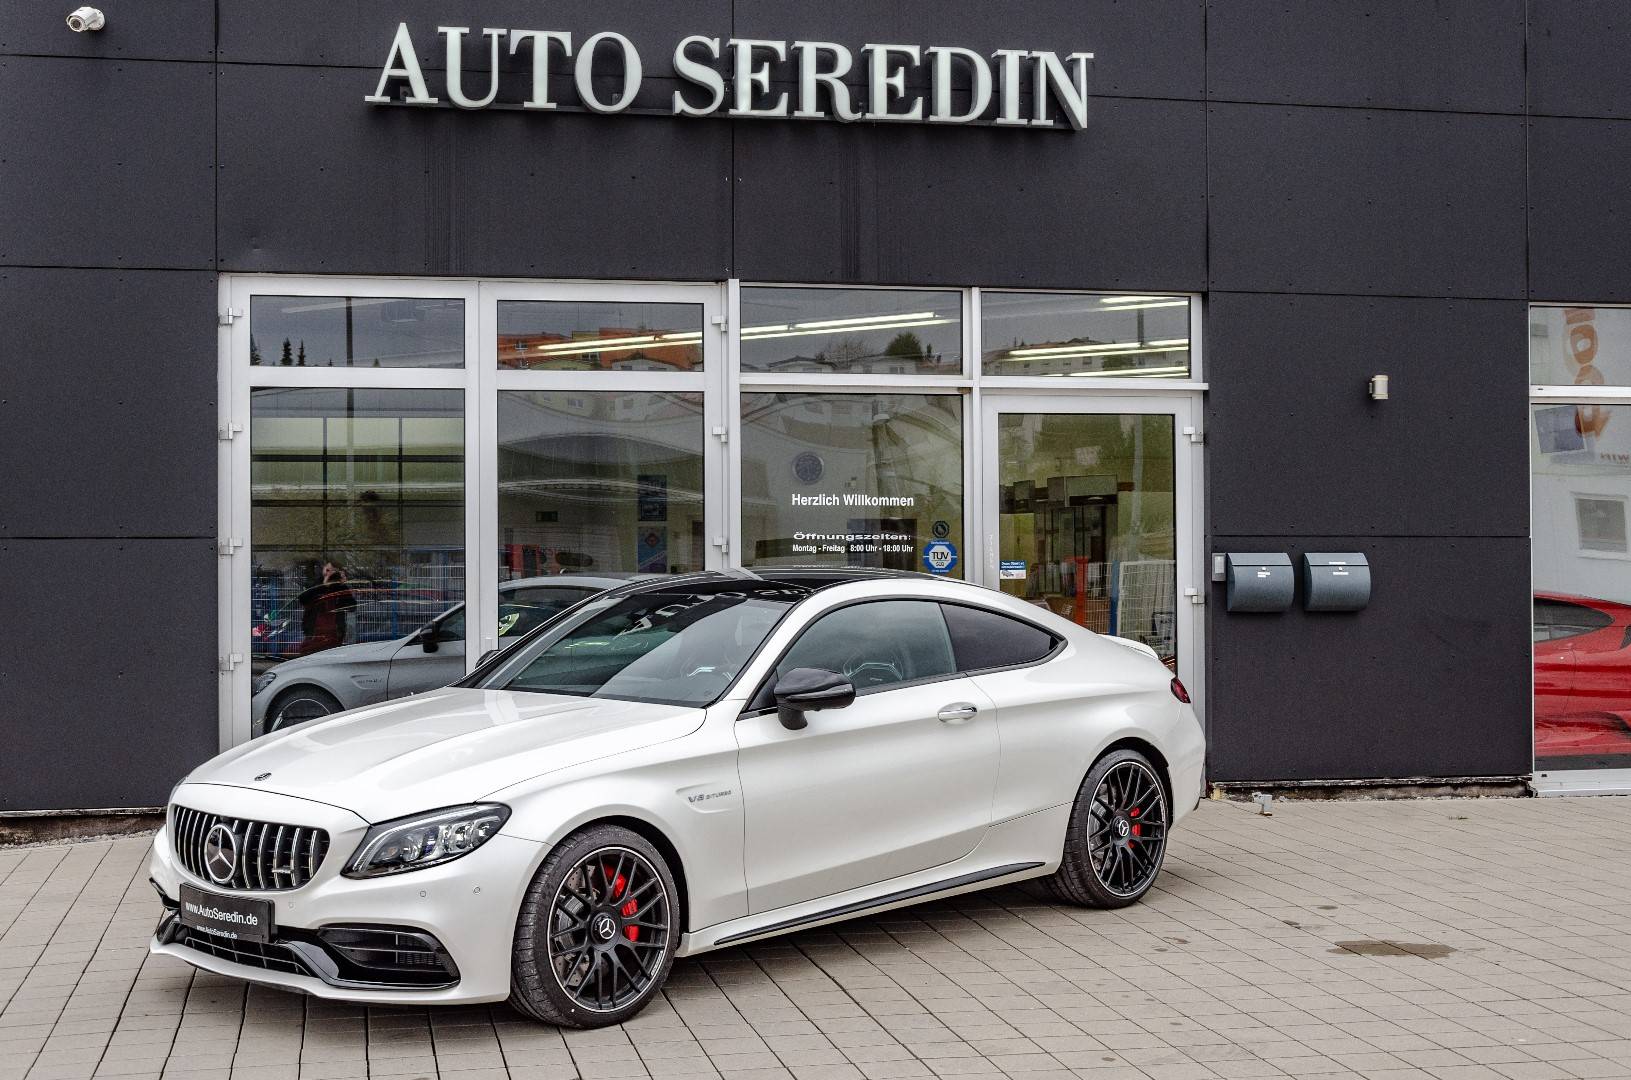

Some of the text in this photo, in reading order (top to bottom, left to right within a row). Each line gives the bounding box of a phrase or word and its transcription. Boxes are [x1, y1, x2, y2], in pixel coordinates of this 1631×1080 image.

[364, 22, 1095, 130] AUTO SEREDIN
[791, 493, 914, 507] Herzlich Willkommen
[793, 531, 911, 541] Öffnungszeiten:
[792, 544, 817, 554] Montag
[822, 544, 846, 554] Freitag
[850, 544, 864, 552] 8:00
[865, 544, 877, 552] Uhr
[882, 544, 901, 552] 18:00
[901, 544, 914, 552] Uhr
[185, 901, 258, 926] www.AutoSeredin.de
